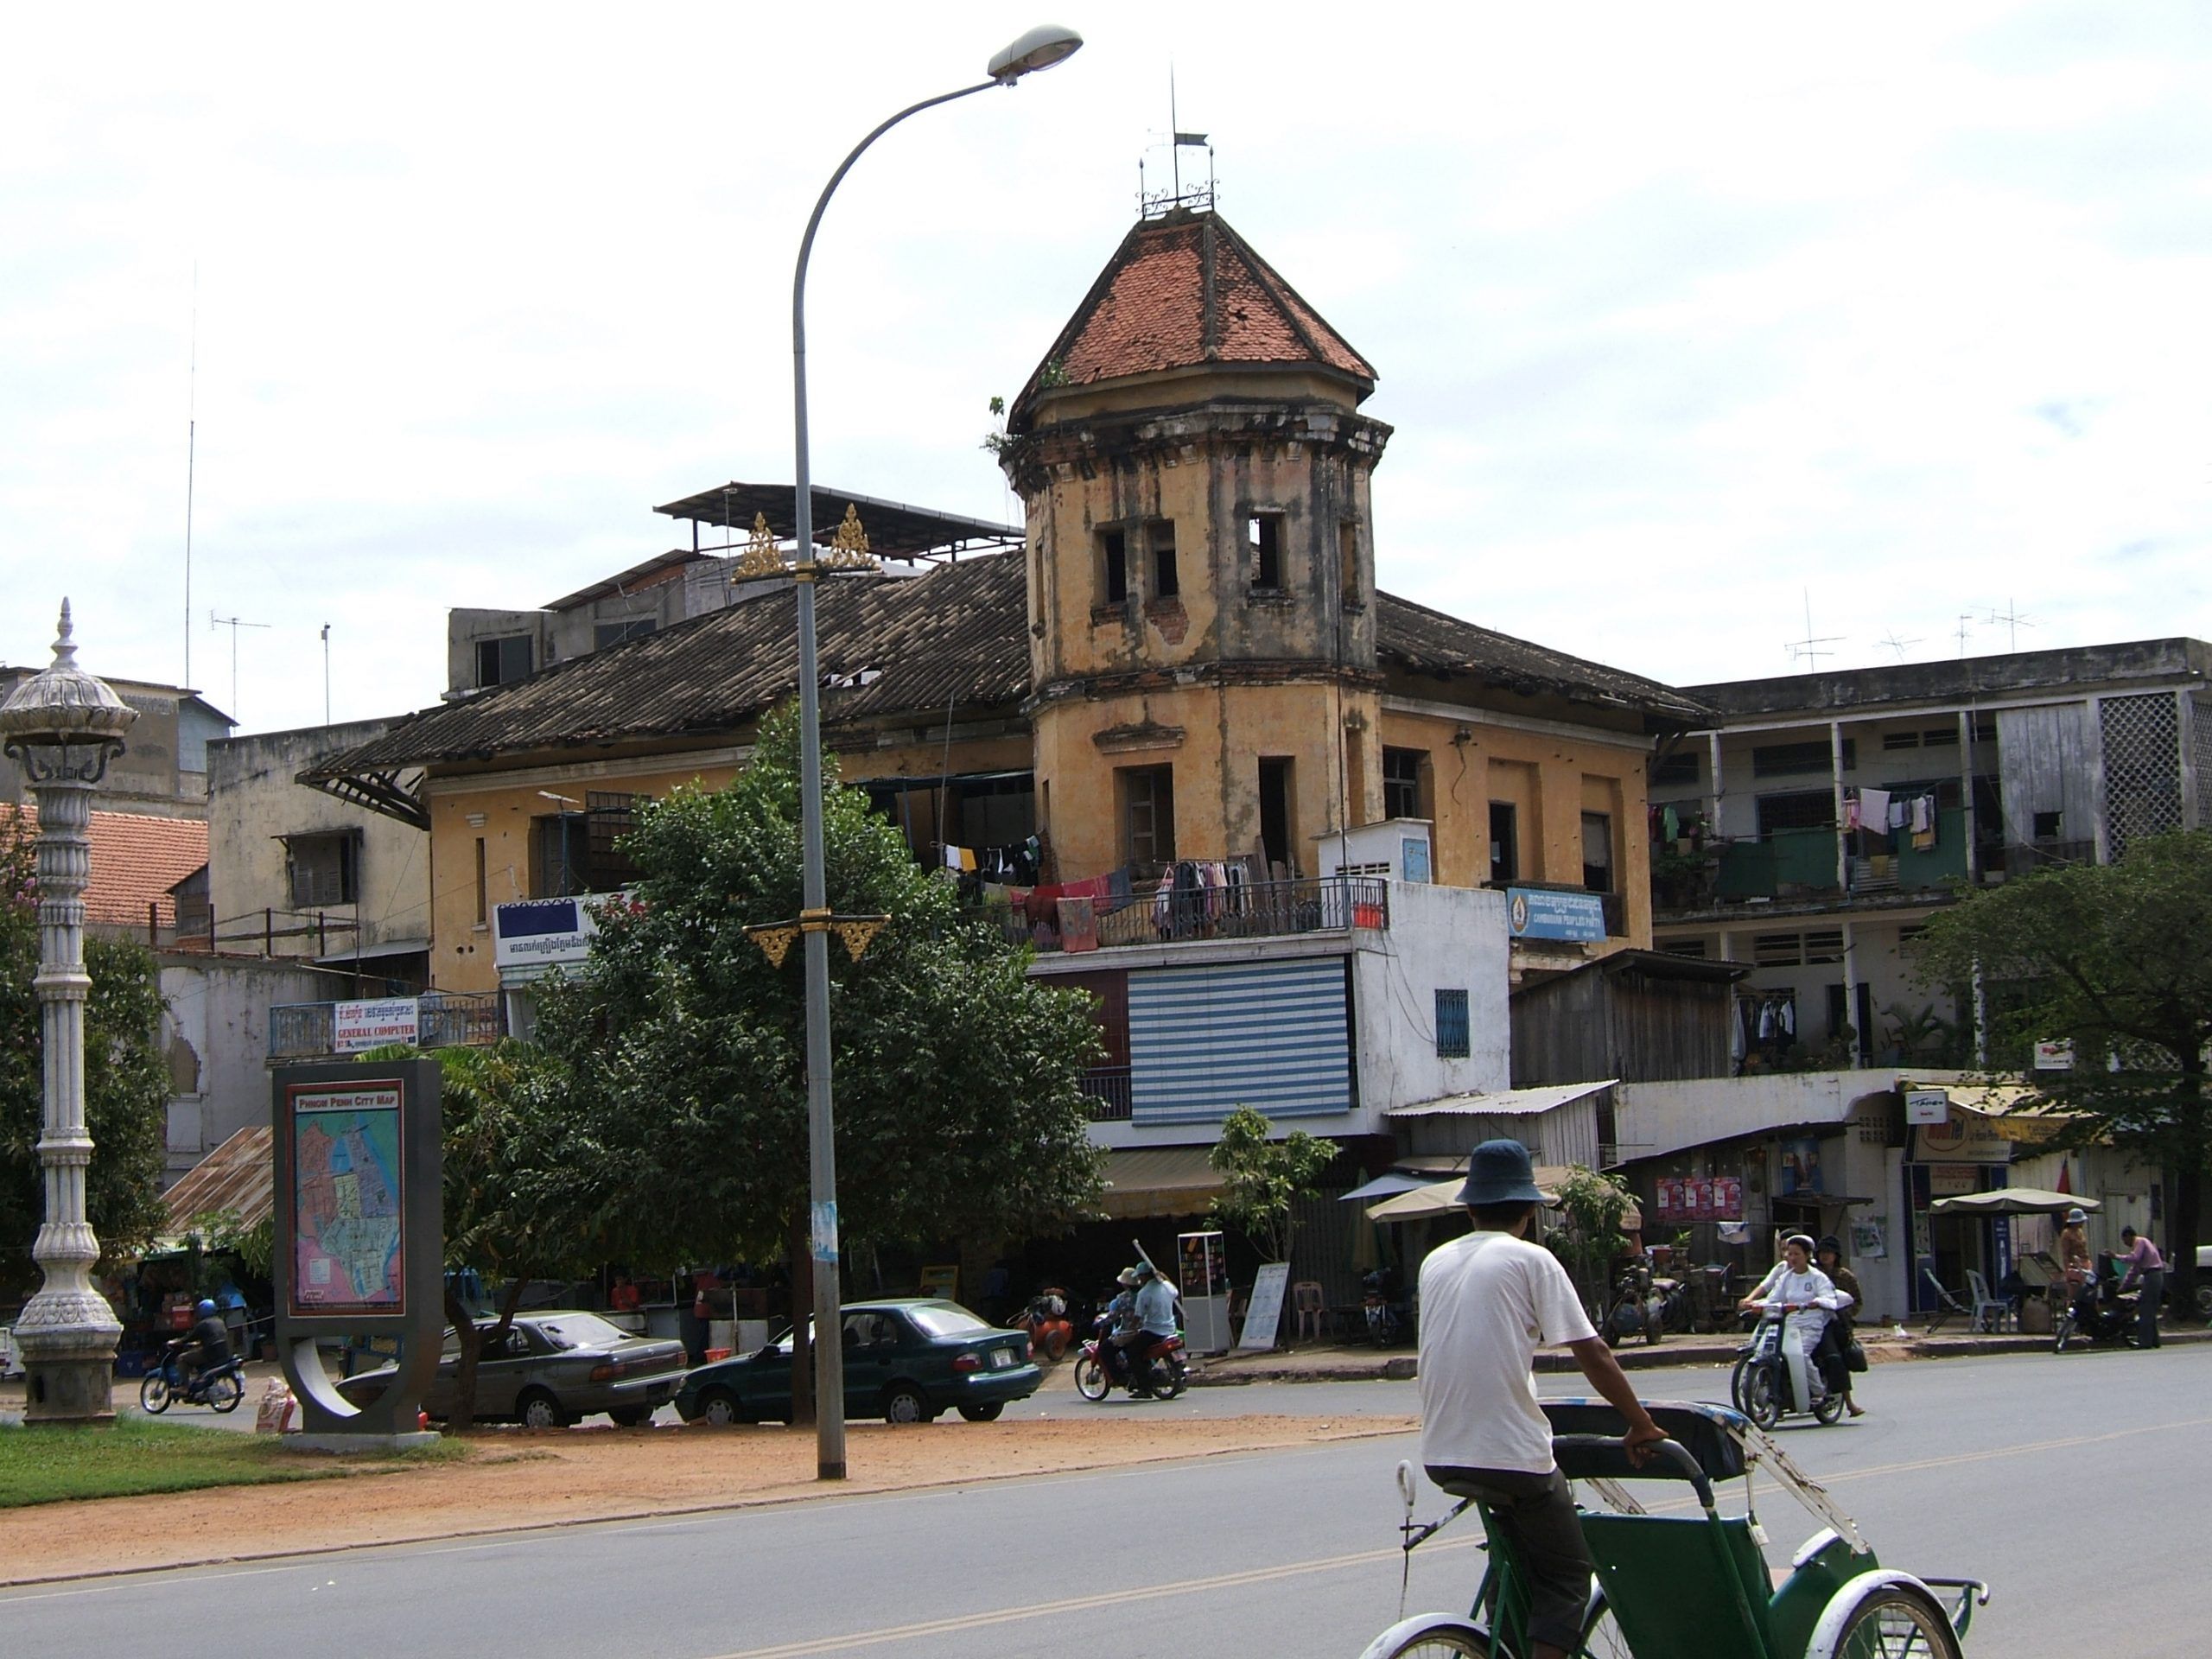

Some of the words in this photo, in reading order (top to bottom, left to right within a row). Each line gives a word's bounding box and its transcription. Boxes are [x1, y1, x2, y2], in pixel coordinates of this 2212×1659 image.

[338, 1027, 372, 1039] GENERAL
[374, 1024, 416, 1036] COMPUTER
[299, 1098, 328, 1109] PHNOM
[330, 1096, 353, 1107] PENH
[354, 1096, 374, 1106] CITY
[376, 1094, 395, 1105] MAP
